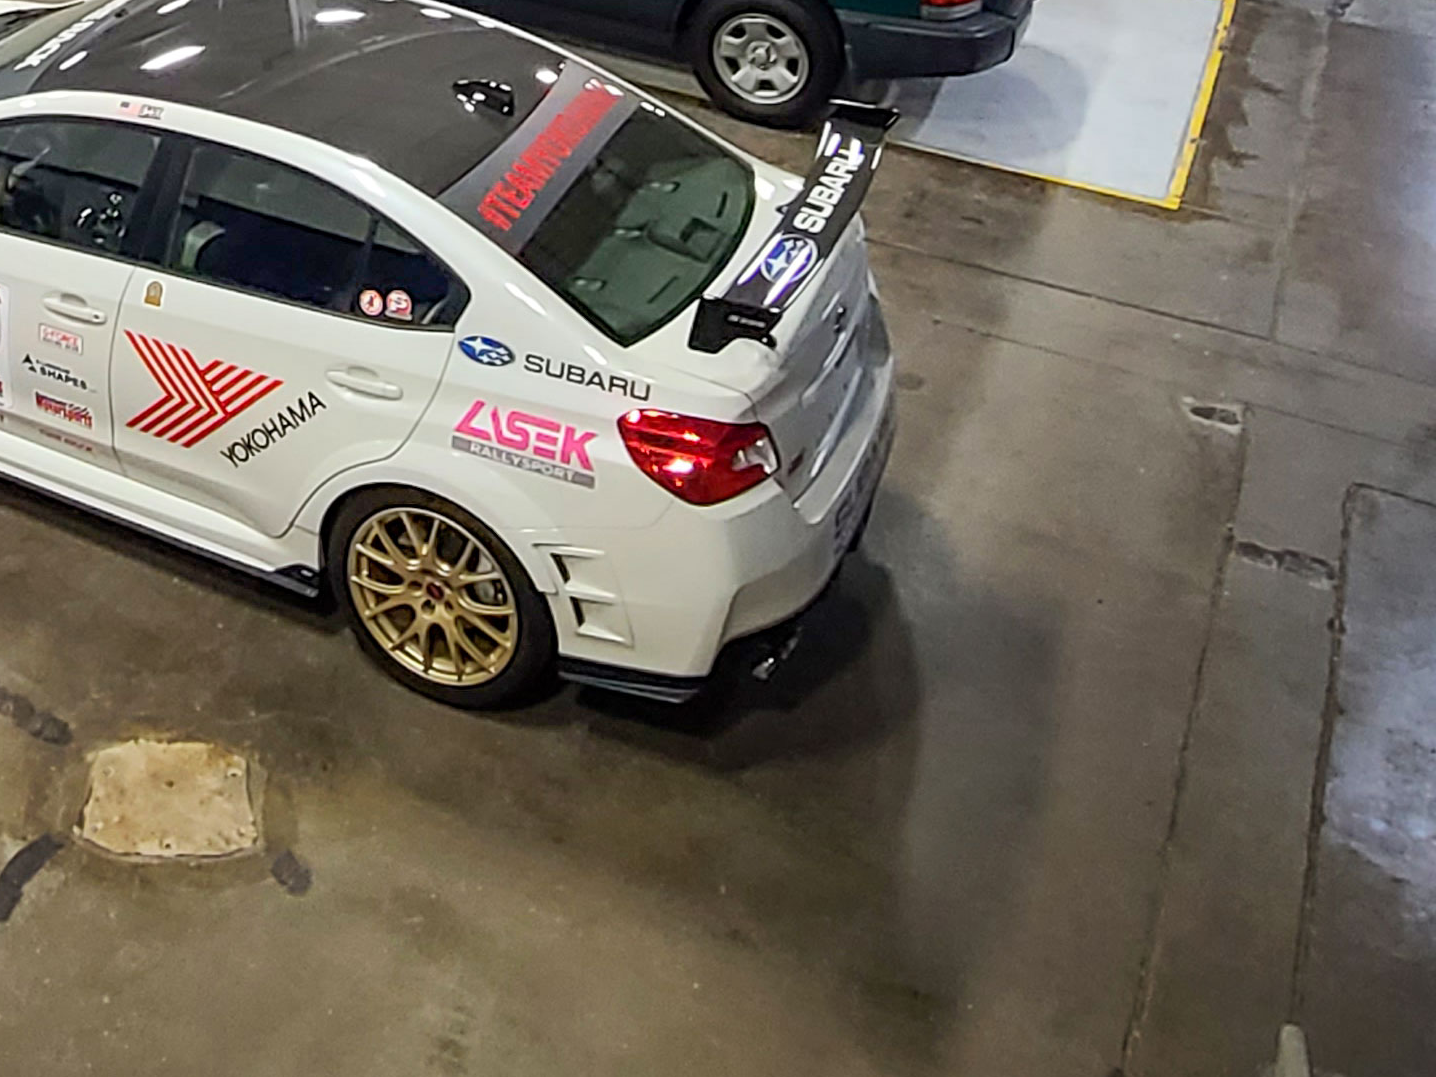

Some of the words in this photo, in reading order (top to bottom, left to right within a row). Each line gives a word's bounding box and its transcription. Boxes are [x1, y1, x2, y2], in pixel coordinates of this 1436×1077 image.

[792, 144, 866, 234] SUBARU
[39, 366, 87, 390] SHAPES
[523, 353, 652, 402] SUBARU
[220, 391, 327, 469] YOKOHAMA
[469, 441, 580, 483] RALLYSPORT
